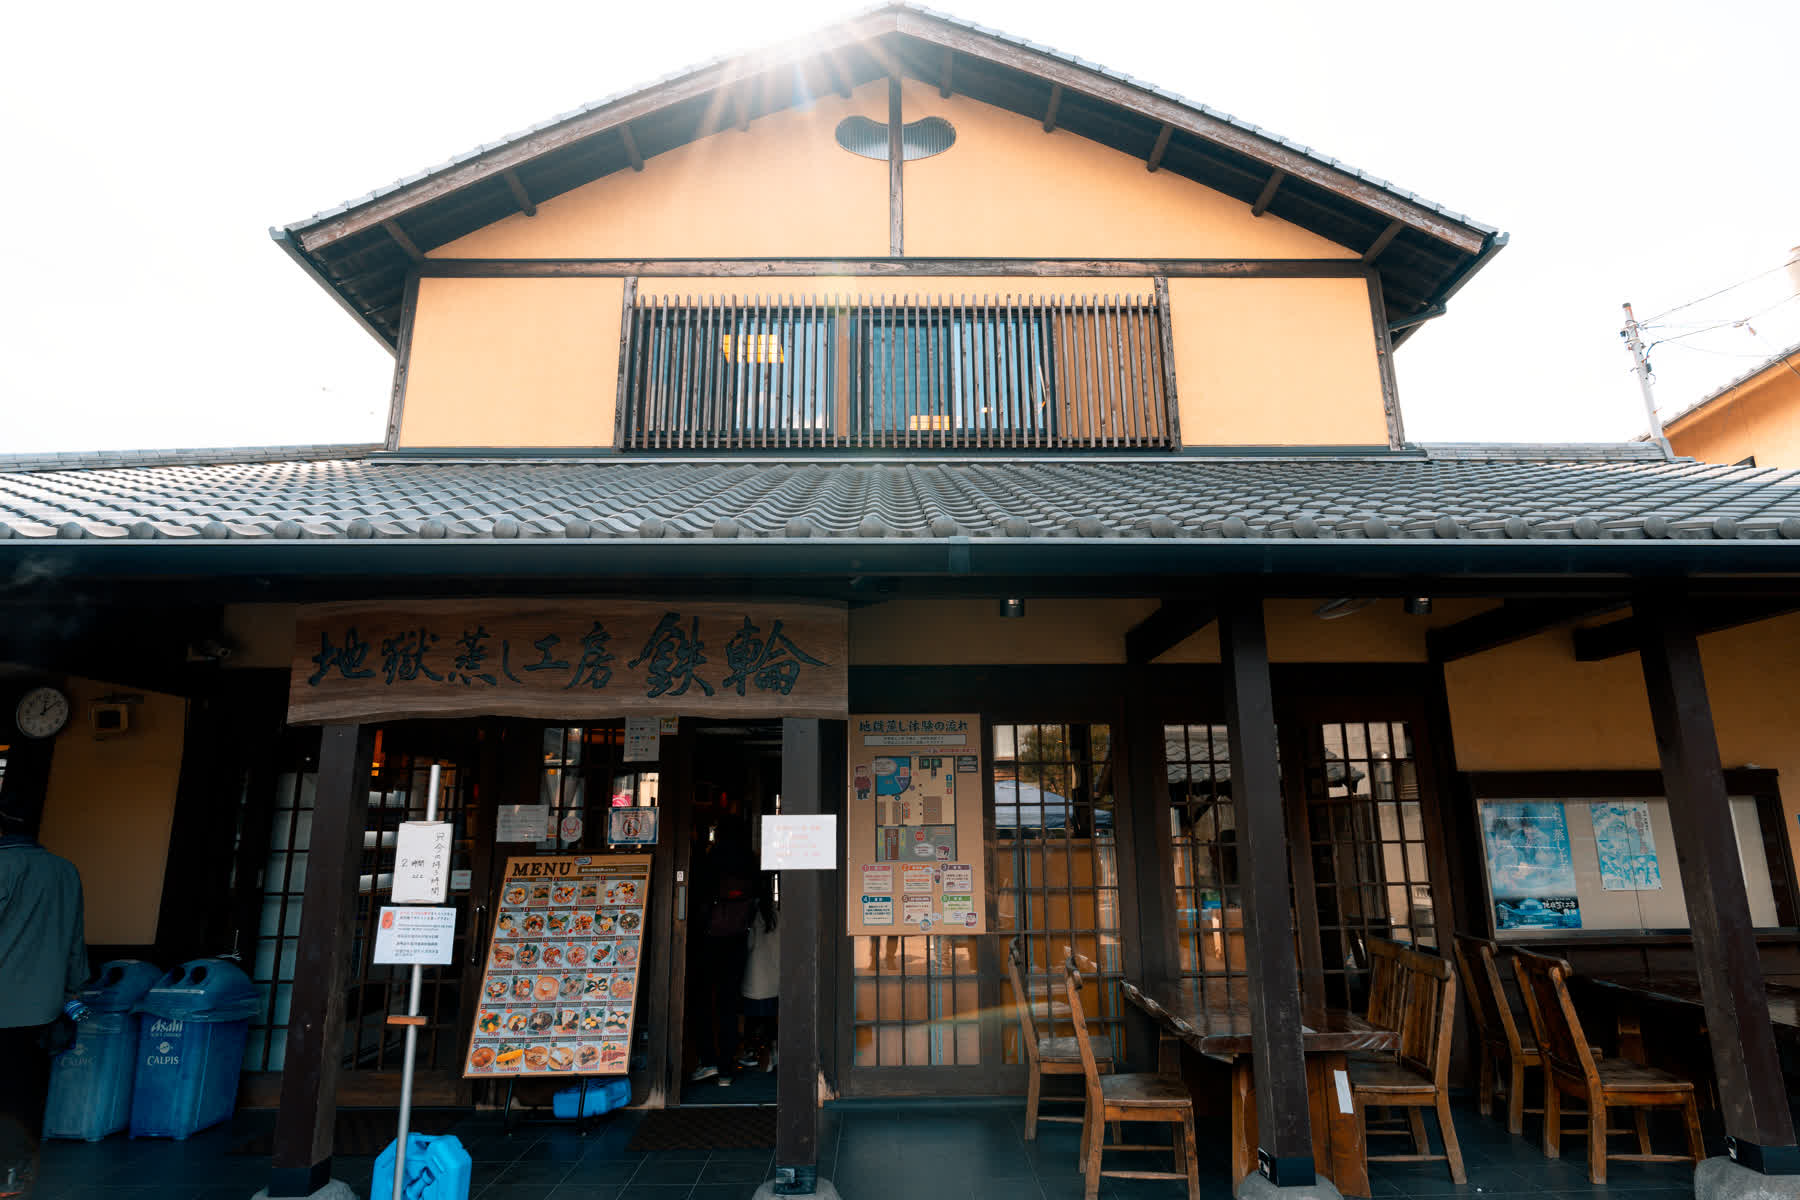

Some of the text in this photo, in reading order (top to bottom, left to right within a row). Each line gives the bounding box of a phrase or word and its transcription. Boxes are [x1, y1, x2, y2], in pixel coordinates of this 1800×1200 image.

[858, 719, 969, 732] 地獄蒸し体験の流れ
[401, 858, 409, 868] 2
[512, 862, 572, 876] MENU
[150, 1018, 183, 1033] Asahi
[147, 1055, 179, 1065] CALPIS
